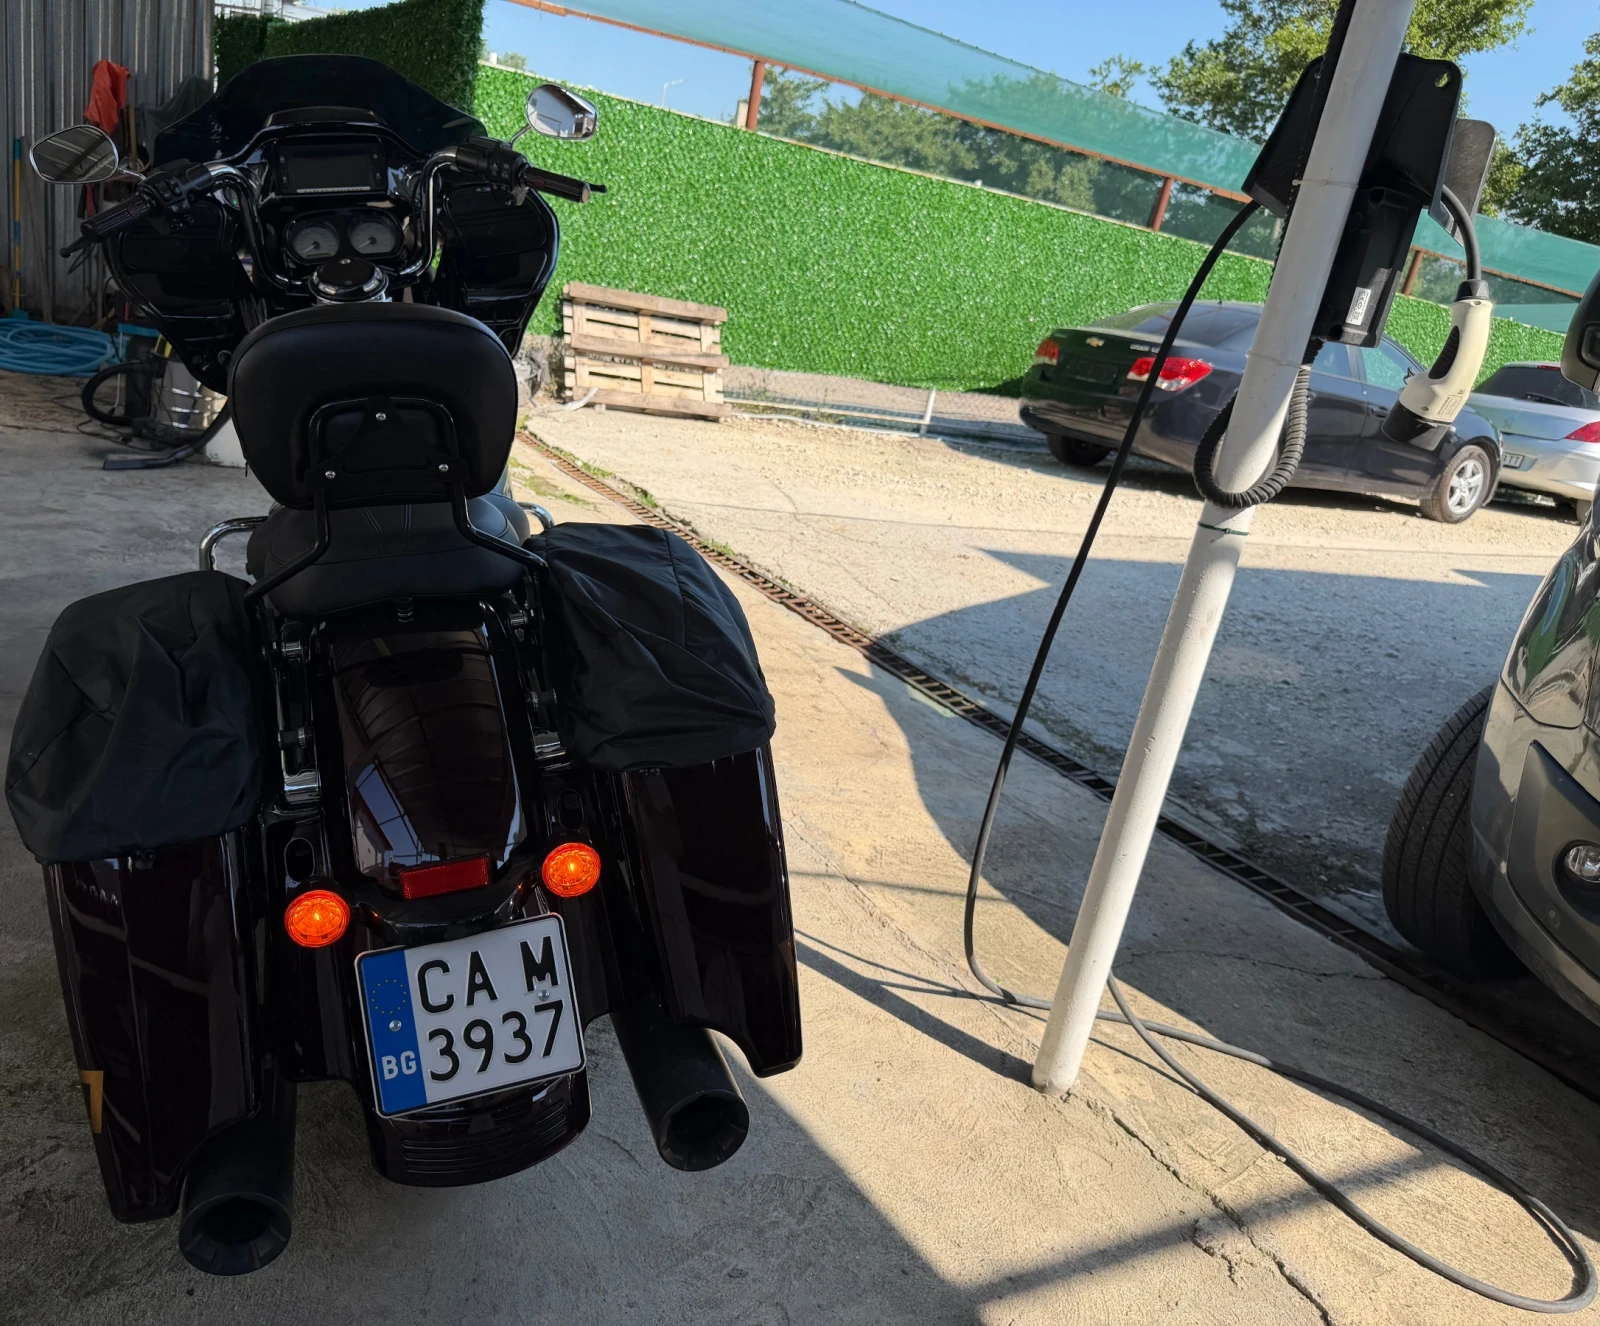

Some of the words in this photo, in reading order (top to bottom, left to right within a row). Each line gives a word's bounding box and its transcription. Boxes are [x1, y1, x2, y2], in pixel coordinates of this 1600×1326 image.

[417, 950, 499, 1014] CA
[519, 935, 559, 992] M
[381, 1050, 418, 1080] BG
[427, 1000, 564, 1082] 3937
